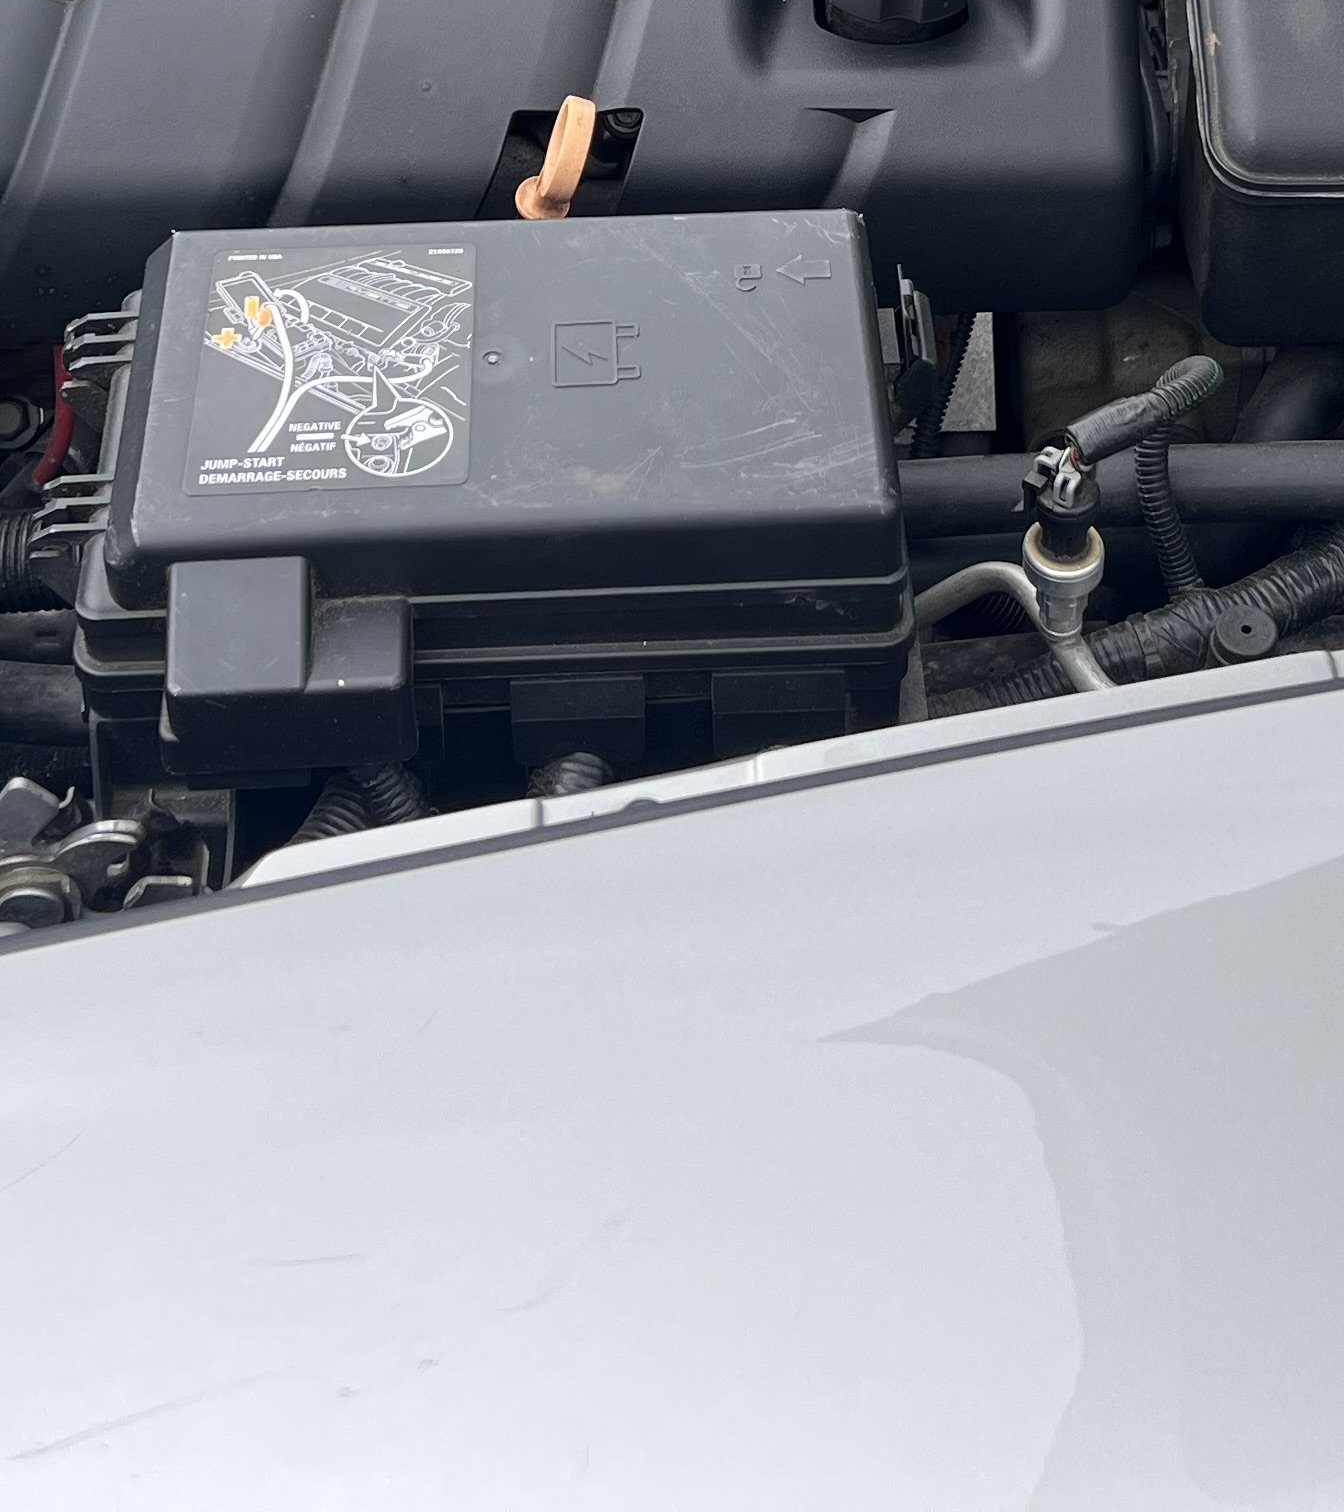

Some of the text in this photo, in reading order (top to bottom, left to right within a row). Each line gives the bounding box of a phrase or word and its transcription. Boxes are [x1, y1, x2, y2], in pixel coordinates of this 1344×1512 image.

[288, 421, 342, 432] NEGATIVE
[289, 441, 337, 453] NÉGATIF
[200, 456, 286, 471] JUMP-START
[198, 468, 348, 485] DEMARRAGE-SECOURS
